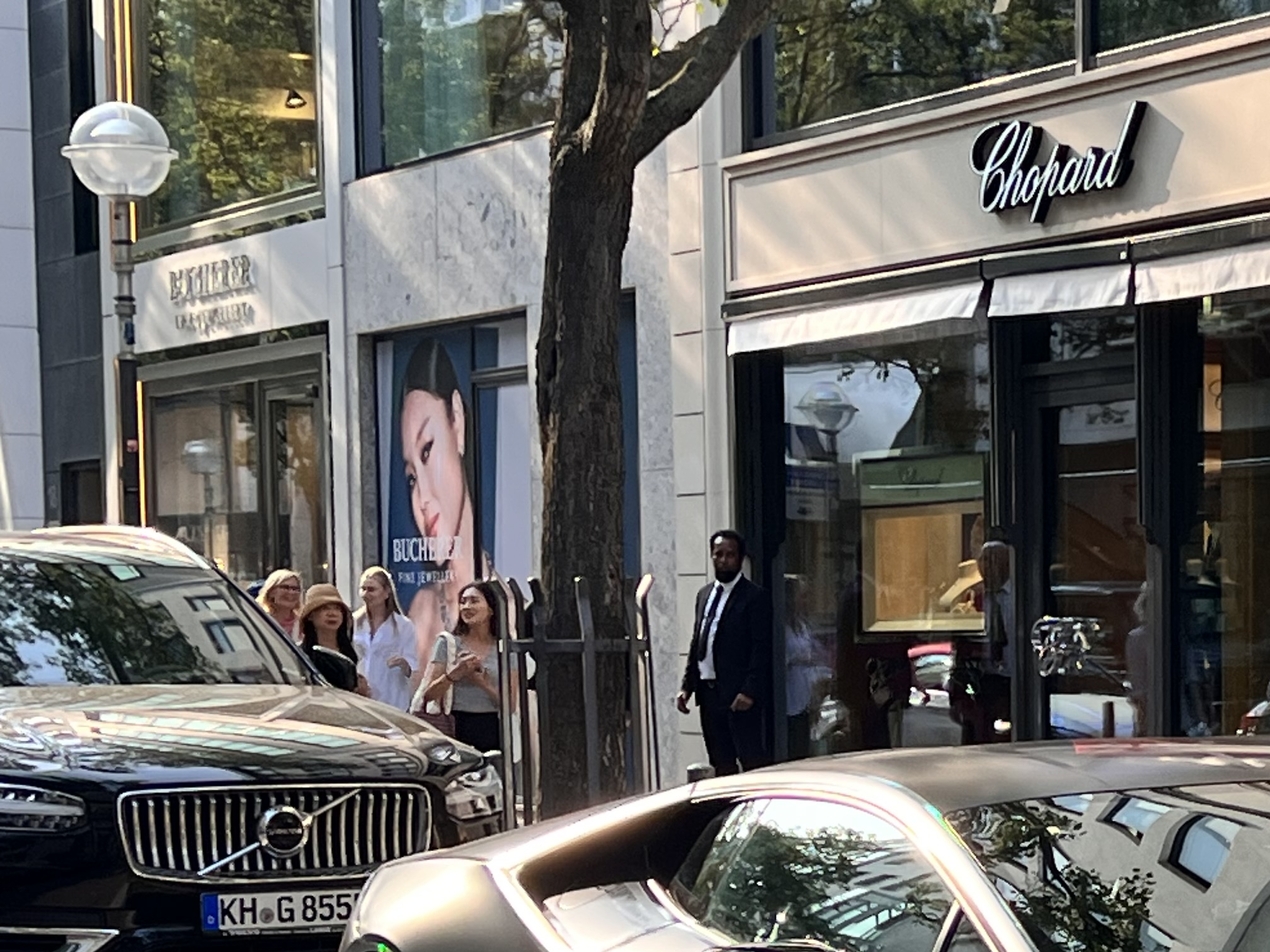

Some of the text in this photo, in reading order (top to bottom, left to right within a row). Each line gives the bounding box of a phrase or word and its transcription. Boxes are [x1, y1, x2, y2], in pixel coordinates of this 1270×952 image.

[970, 101, 1142, 223] Chopard
[220, 894, 360, 925] KH G 855
